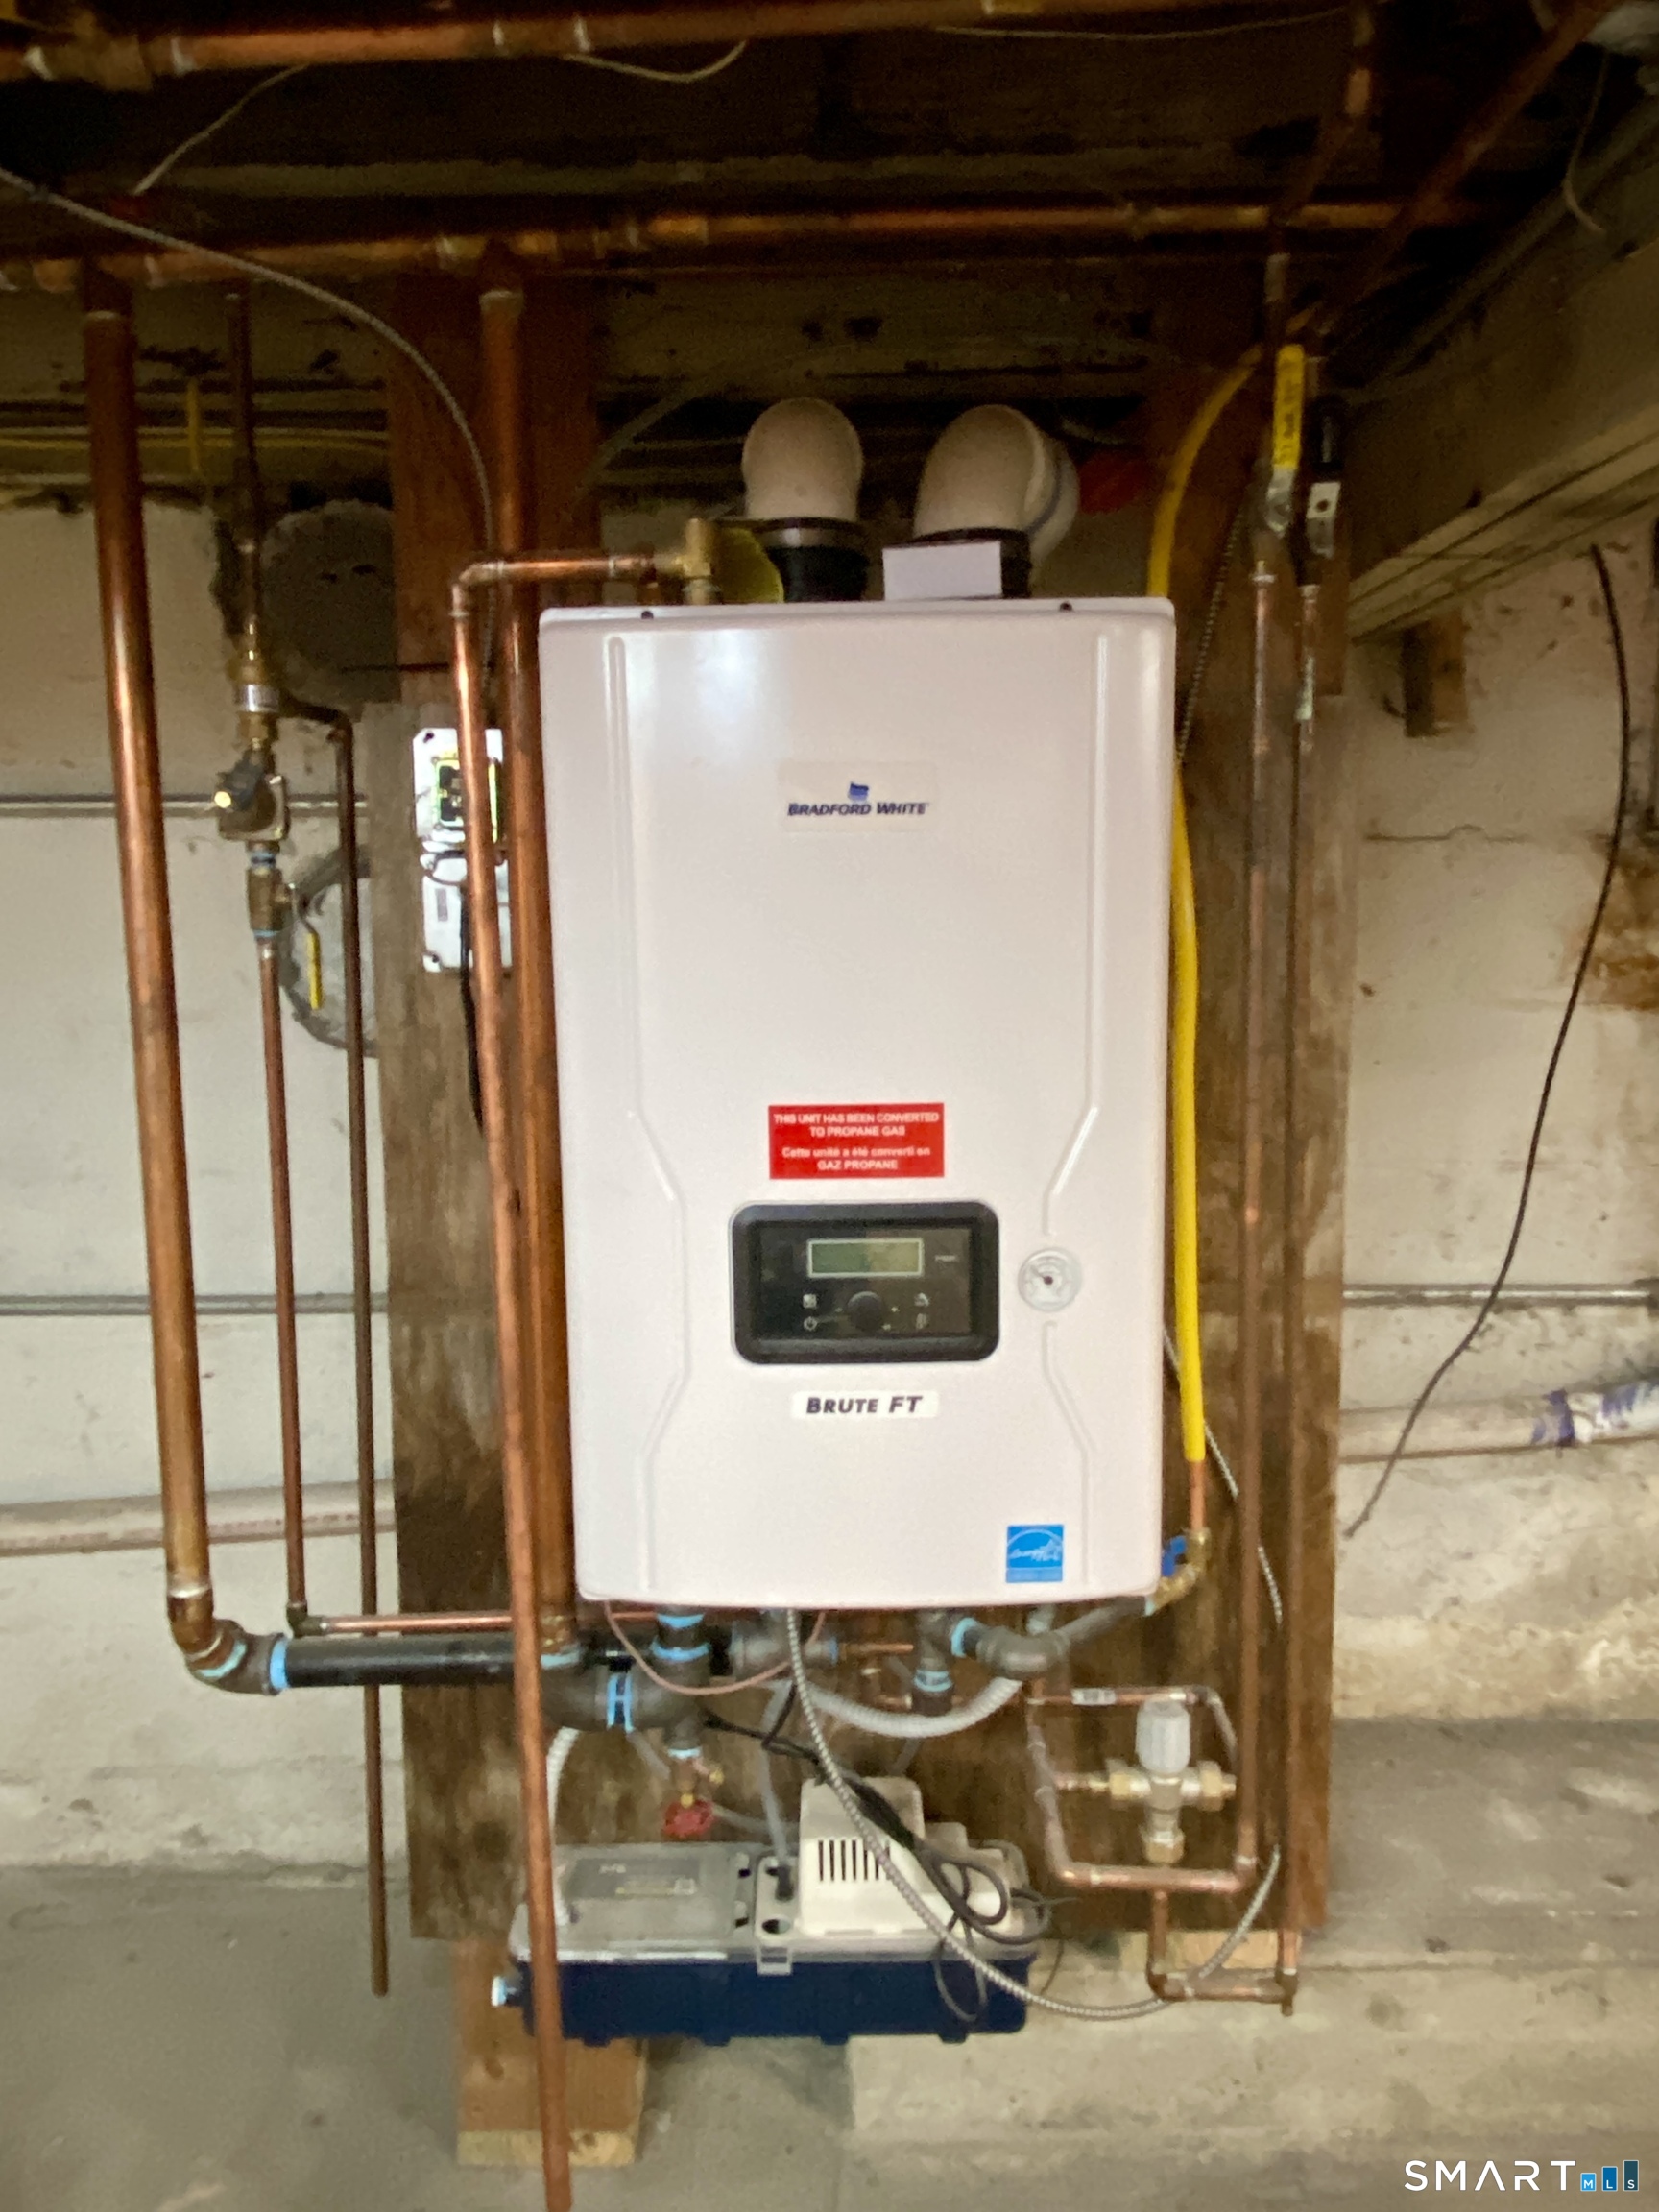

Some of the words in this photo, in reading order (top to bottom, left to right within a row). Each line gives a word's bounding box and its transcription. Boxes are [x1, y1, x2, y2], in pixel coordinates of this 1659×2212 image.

[787, 803, 872, 816] BRADFORD
[877, 802, 928, 815] WHITE
[774, 1114, 796, 1124] THIS
[798, 1114, 822, 1123] UNIT
[823, 1114, 844, 1123] HAS
[846, 1113, 875, 1123] BEEN
[877, 1112, 939, 1123] CONVERTED
[809, 1127, 825, 1137] TO
[827, 1126, 879, 1137] PROPANE
[881, 1125, 905, 1136] GAS
[817, 1161, 842, 1171] GAZ
[844, 1160, 899, 1170] PROPANE
[805, 1397, 878, 1414] BRUTE
[888, 1395, 924, 1413] FT
